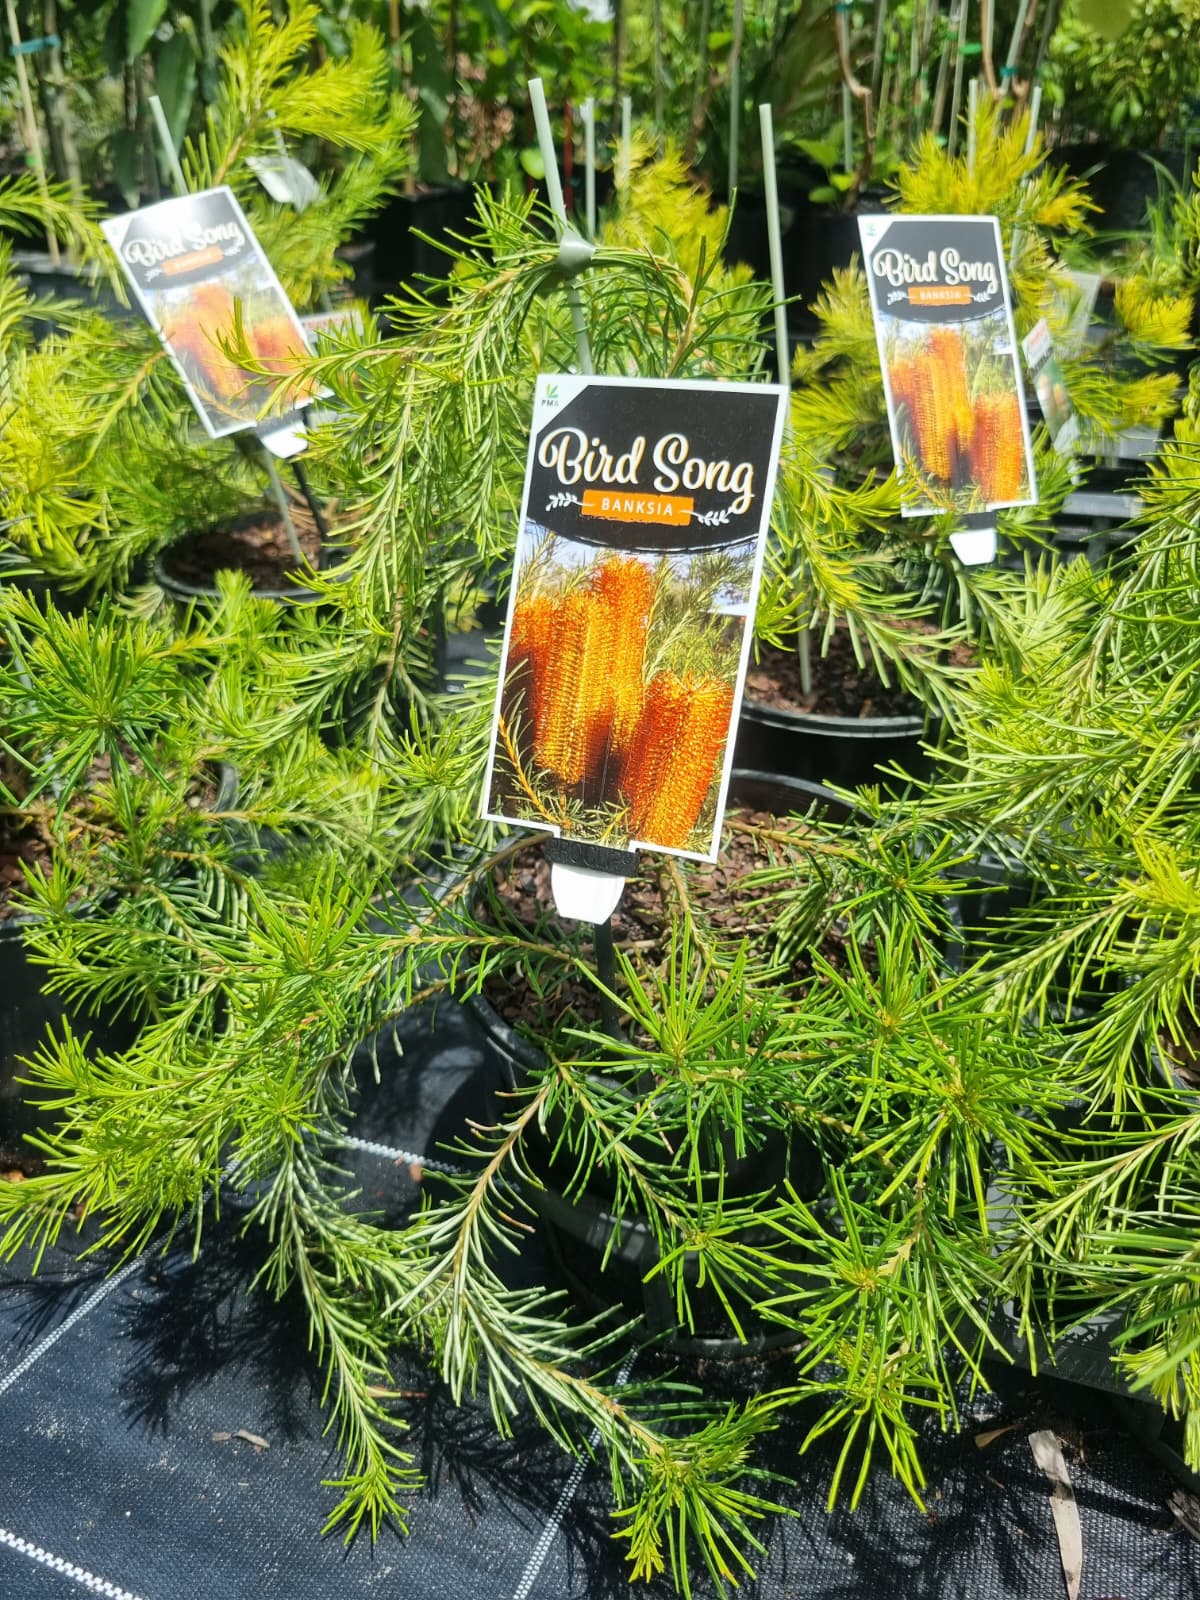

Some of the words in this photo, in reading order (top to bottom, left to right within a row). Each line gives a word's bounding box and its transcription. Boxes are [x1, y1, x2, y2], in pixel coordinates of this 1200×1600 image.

[124, 226, 185, 267] Bird
[873, 248, 938, 287] Bird
[940, 247, 998, 294] Song
[538, 427, 646, 485] Bird
[653, 433, 755, 514] Song
[601, 497, 674, 517] BANKSIA
